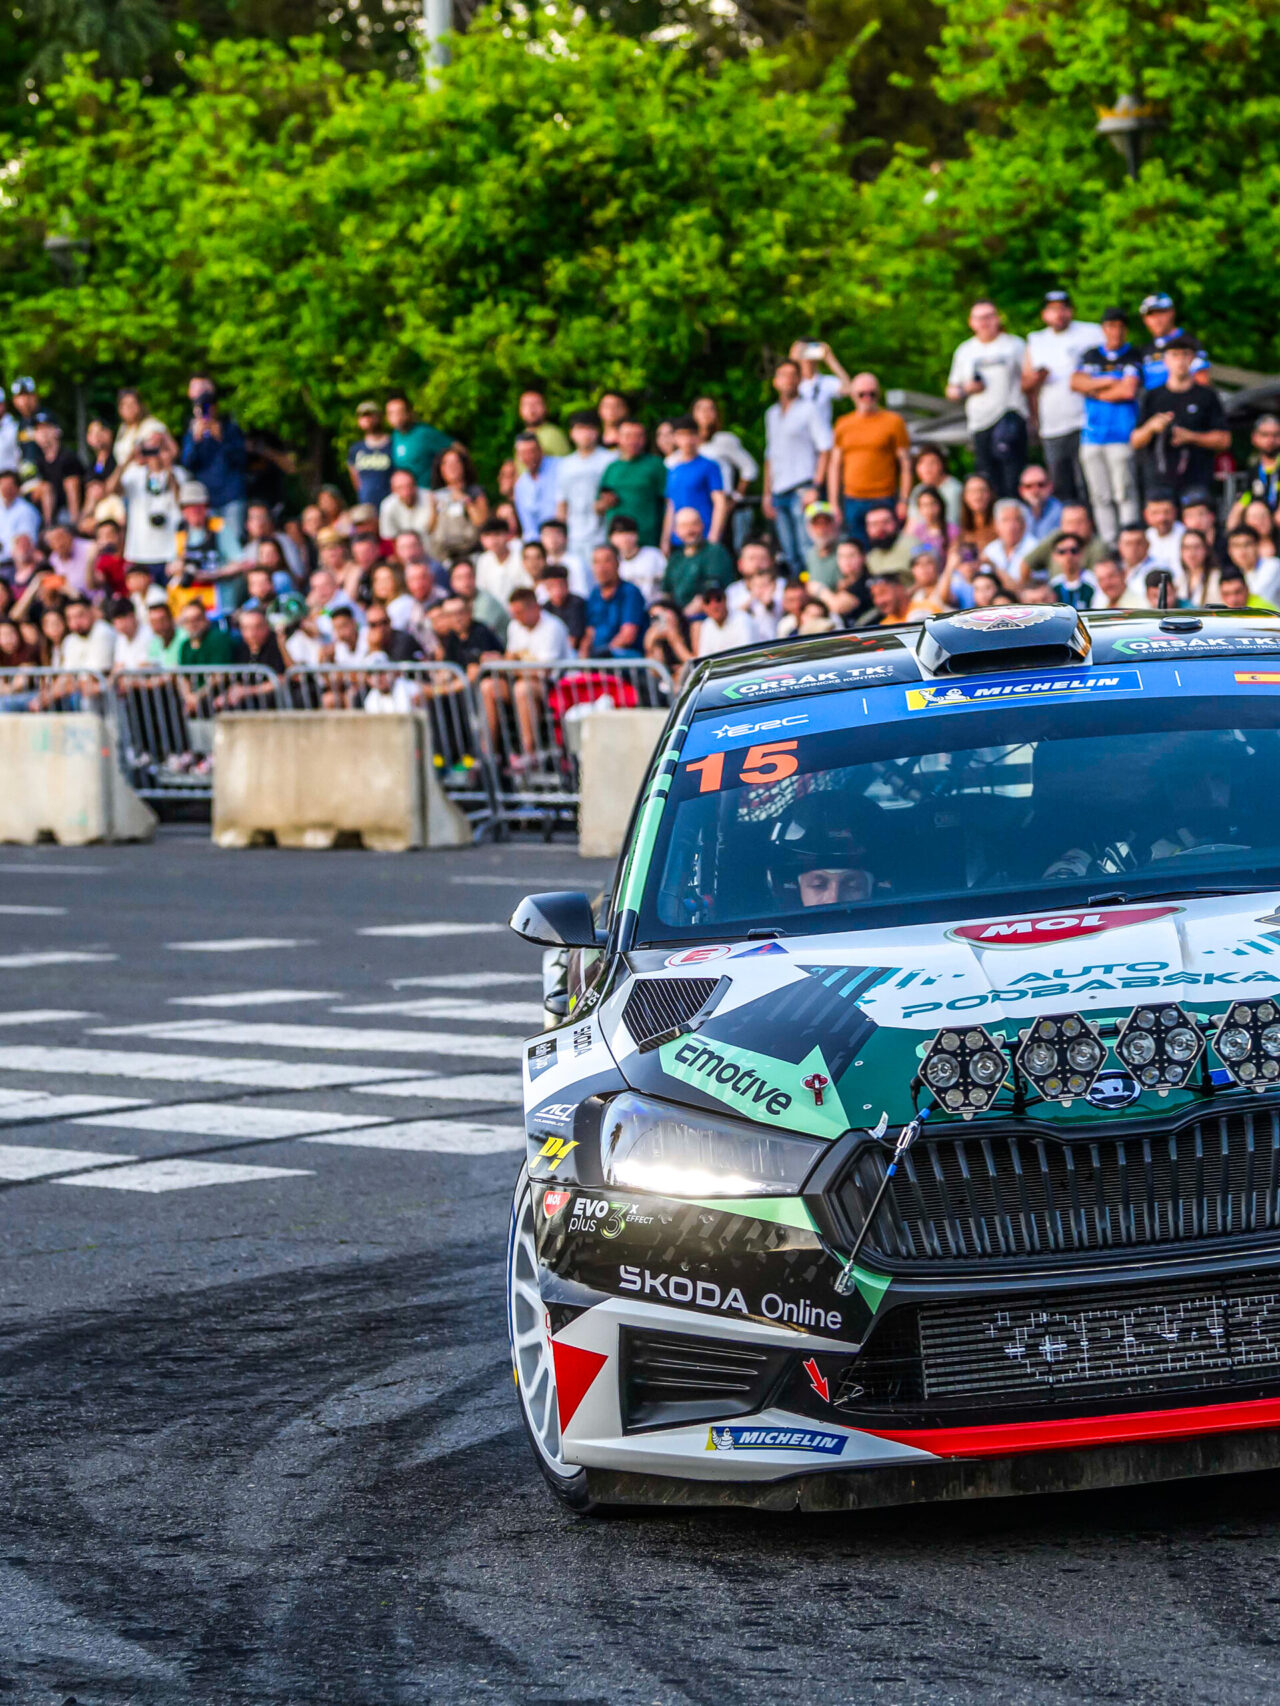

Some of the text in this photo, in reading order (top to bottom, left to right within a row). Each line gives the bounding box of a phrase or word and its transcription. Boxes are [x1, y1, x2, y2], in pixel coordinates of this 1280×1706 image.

[1235, 637, 1275, 645] TK
[846, 665, 887, 677] TK
[974, 677, 1120, 697] MICHELIN
[726, 714, 810, 738] ERC
[685, 740, 799, 793] 15
[980, 914, 1108, 938] MOL
[680, 948, 720, 963] E
[1006, 961, 1170, 986] AUTO
[546, 1193, 561, 1206] MOL
[573, 1197, 609, 1218] EVO
[568, 1214, 598, 1232] plus
[625, 1214, 655, 1224] EFFECT
[761, 1293, 843, 1330] Online
[738, 1430, 839, 1449] MICHELIN
